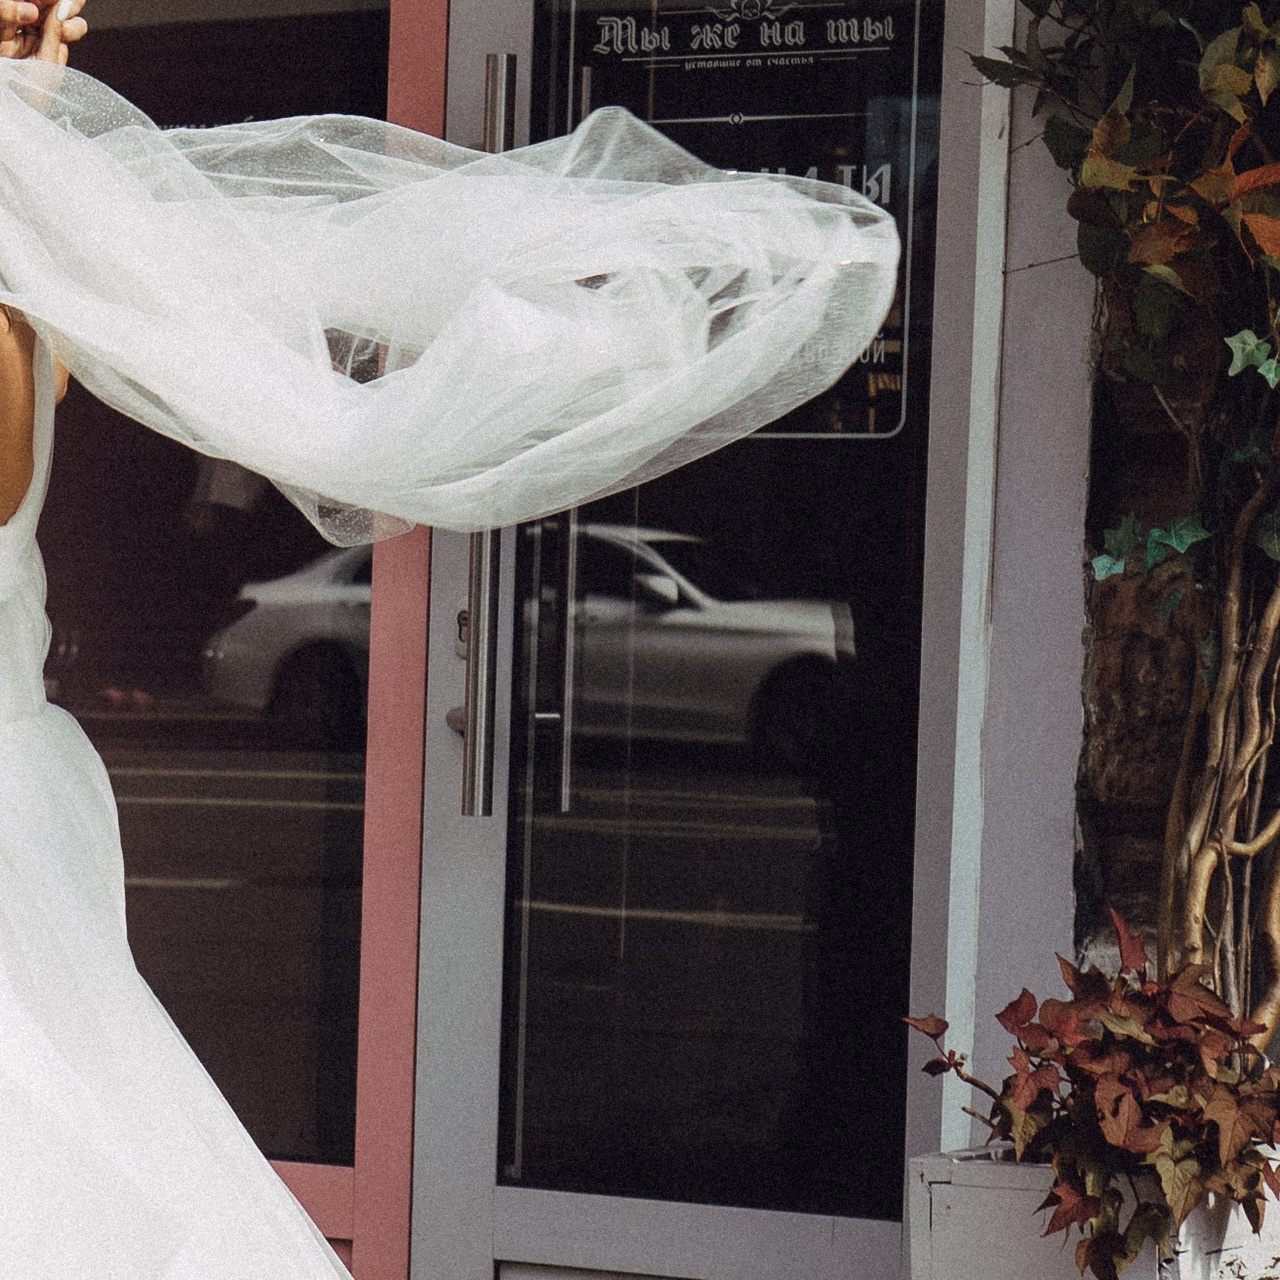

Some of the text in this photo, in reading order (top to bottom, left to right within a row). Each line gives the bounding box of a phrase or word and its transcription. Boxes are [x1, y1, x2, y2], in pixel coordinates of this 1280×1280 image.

[593, 15, 896, 55] Мы же на ты
[746, 59, 763, 68] от
